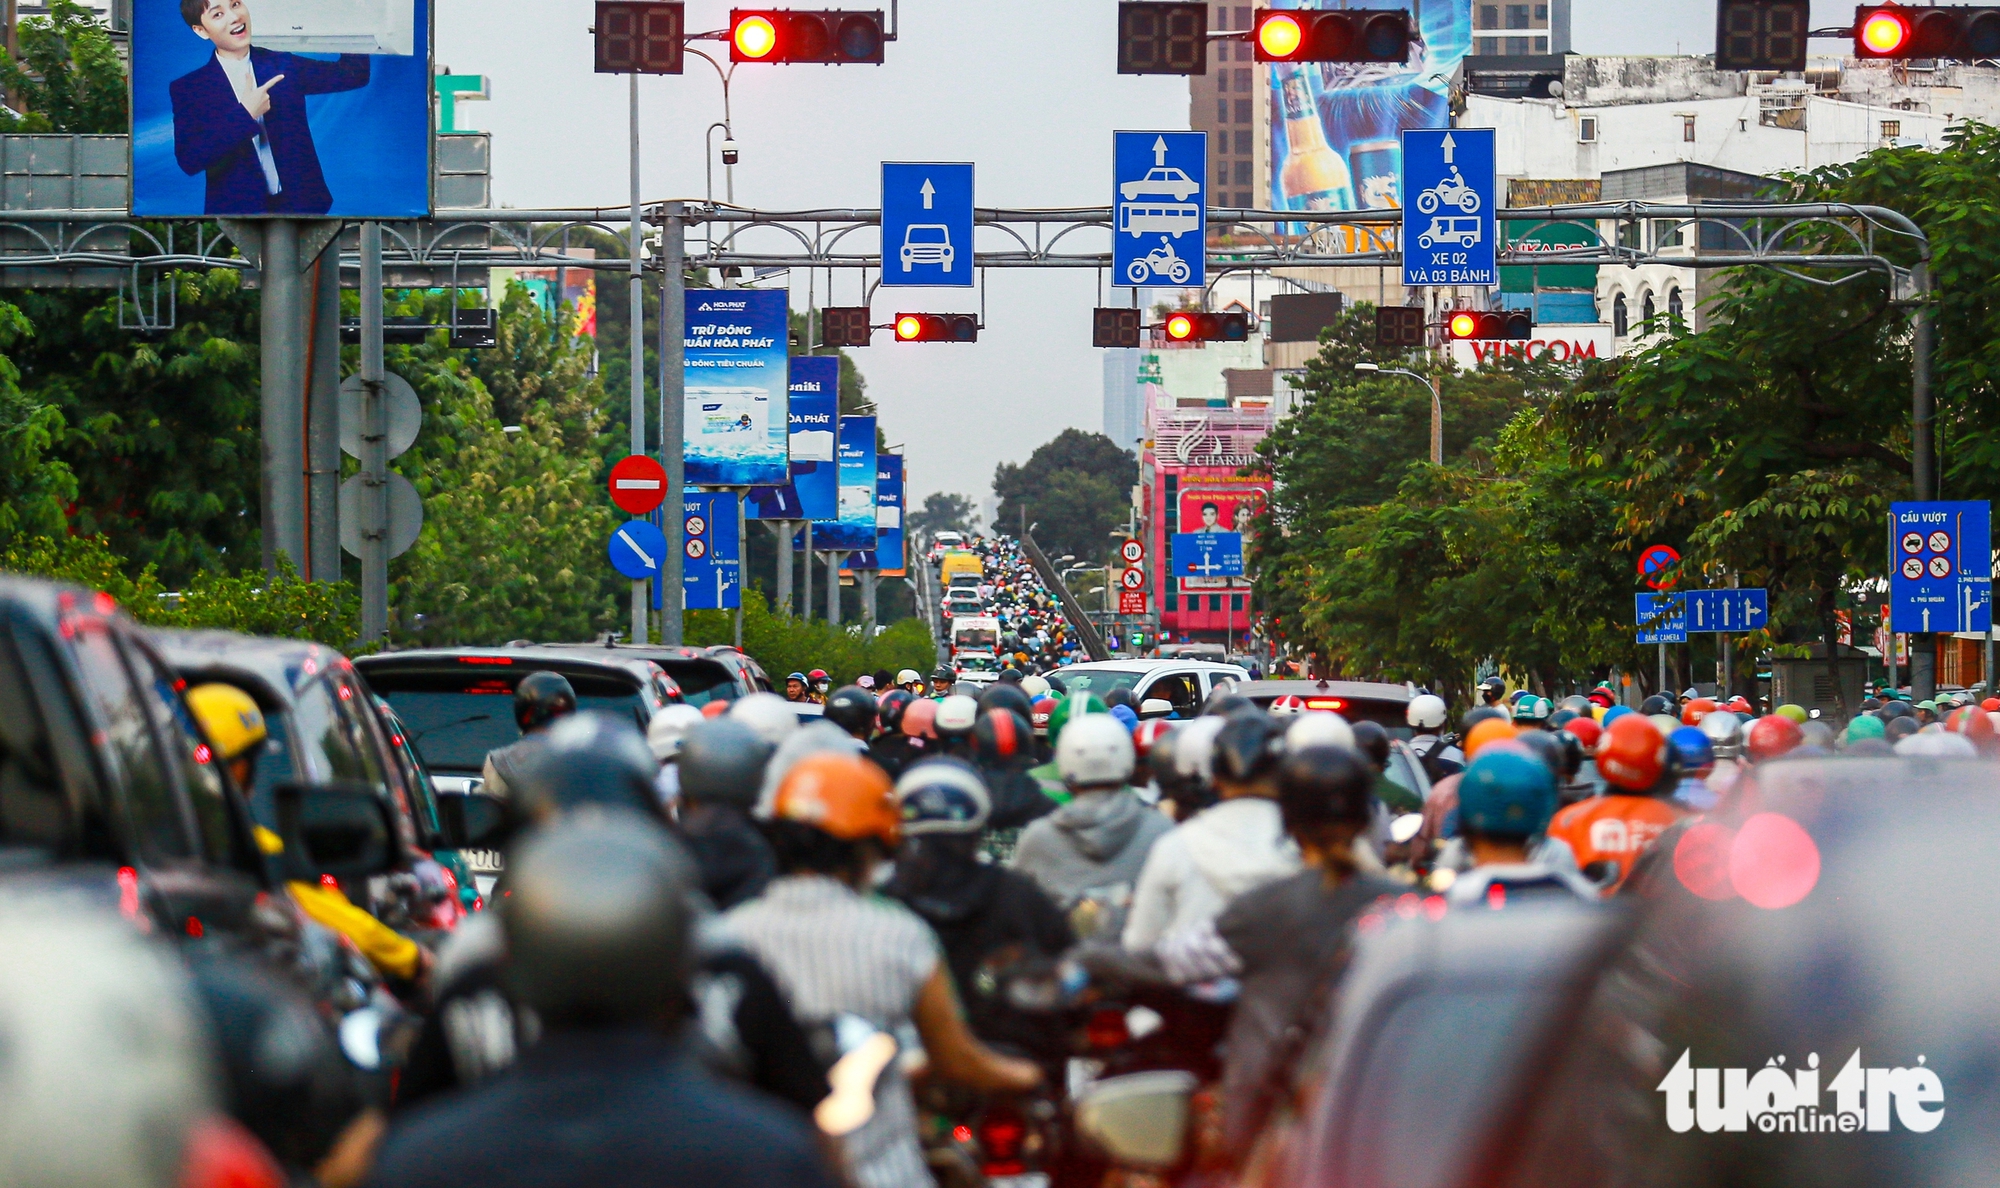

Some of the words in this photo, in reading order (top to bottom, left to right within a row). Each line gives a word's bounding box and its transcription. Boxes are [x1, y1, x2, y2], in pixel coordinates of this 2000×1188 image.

[1431, 252, 1449, 265] XE
[1452, 252, 1467, 265] 02
[1409, 267, 1428, 282] VÀ
[1432, 270, 1447, 282] 03
[1450, 266, 1490, 282] BÁNH
[692, 324, 716, 335] TRỮ
[717, 324, 752, 335] ĐÔNG
[713, 337, 739, 348] HÒA
[741, 337, 774, 348] PHÁT
[1470, 339, 1597, 366] VINCOM
[804, 412, 830, 424] PHÁT
[684, 503, 701, 514] ƯỢT
[1922, 511, 1947, 525] VƯỢT
[1127, 546, 1136, 557] 10
[1660, 633, 1680, 641] CAMERA
